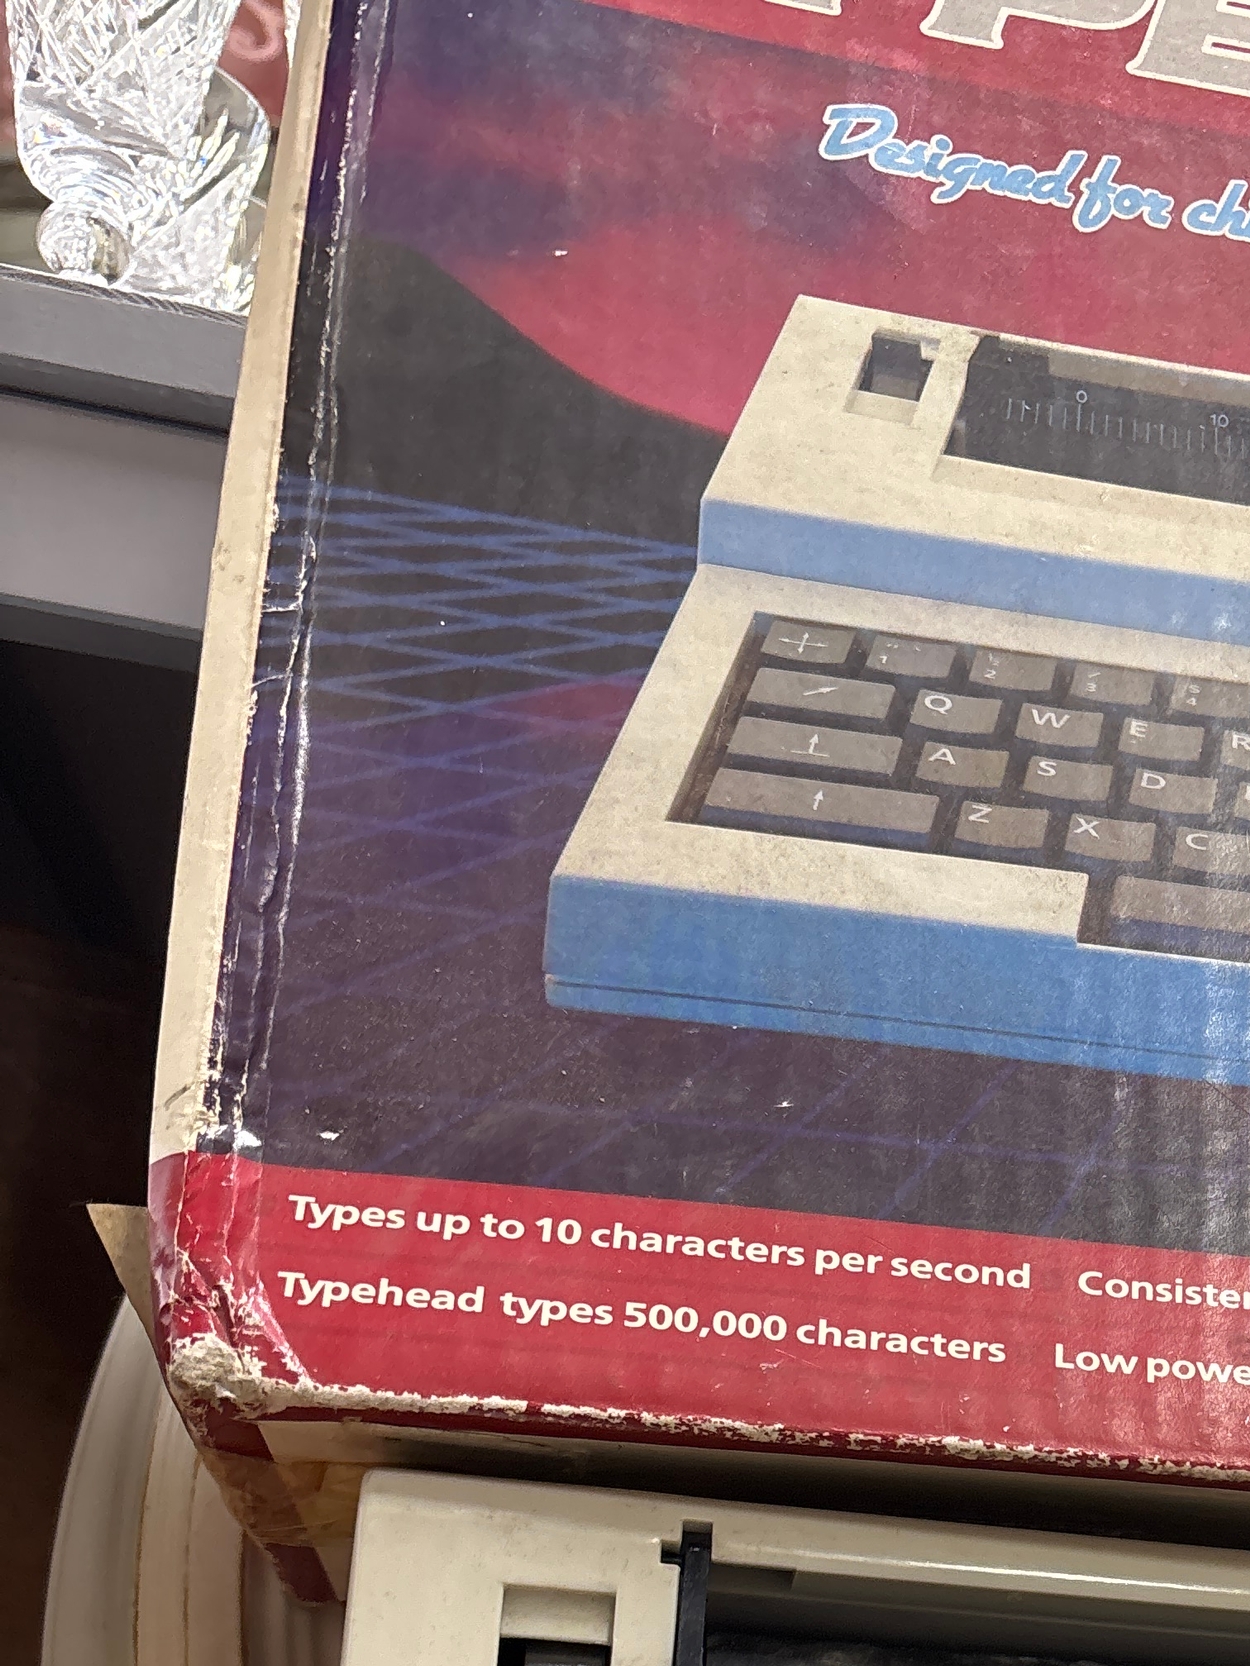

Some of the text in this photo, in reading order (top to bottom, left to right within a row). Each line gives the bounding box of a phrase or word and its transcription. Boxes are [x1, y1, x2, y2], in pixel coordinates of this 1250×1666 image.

[819, 103, 1088, 203] Designed
[1071, 156, 1175, 233] for
[1210, 413, 1230, 428] 10
[924, 694, 954, 716] Q
[1031, 708, 1070, 730] W
[1129, 720, 1148, 738] E
[928, 748, 956, 766] A
[1036, 761, 1058, 778] S
[1141, 773, 1167, 791] D
[968, 803, 993, 823] Z
[1074, 817, 1101, 839] X
[1184, 834, 1209, 851] C
[289, 1194, 1031, 1290] Types up to 10 characters per second
[278, 1271, 1006, 1363] Typehead types 500,000 characters
[1055, 1343, 1139, 1375] Low
